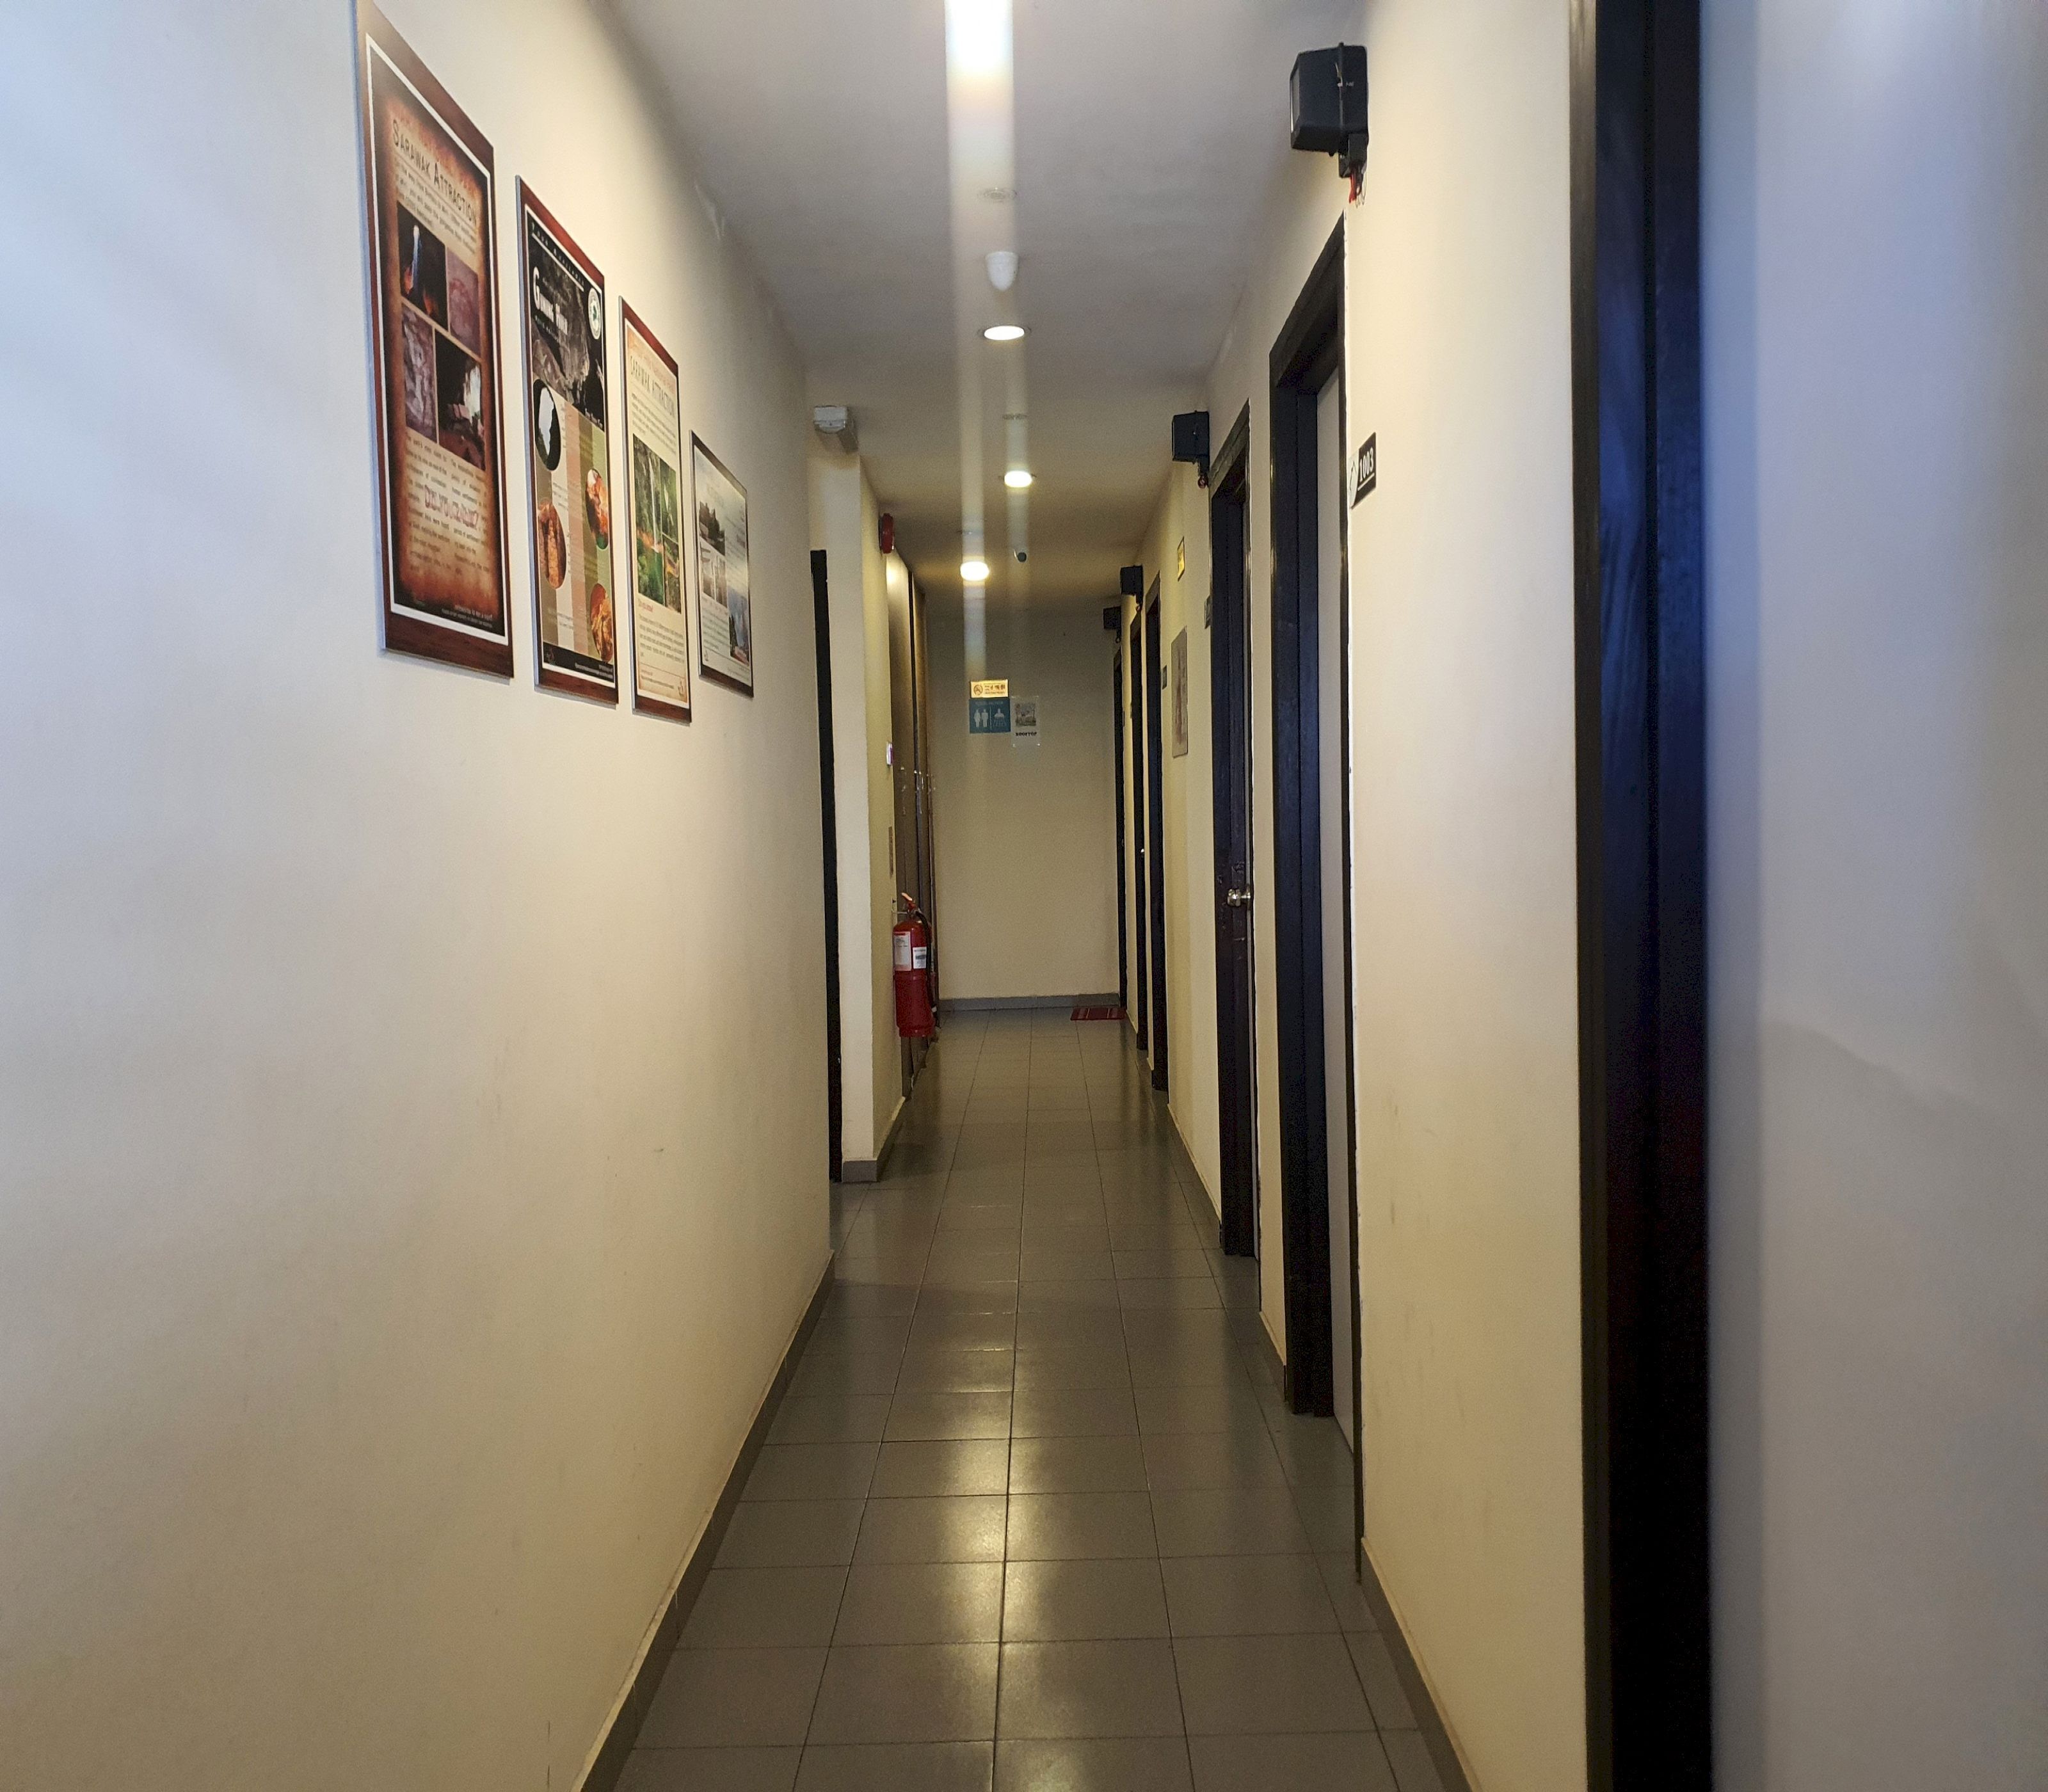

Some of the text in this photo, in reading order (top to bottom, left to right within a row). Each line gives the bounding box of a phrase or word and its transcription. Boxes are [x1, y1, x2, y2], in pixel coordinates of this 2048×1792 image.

[392, 119, 431, 178] SARAWAK
[434, 162, 477, 225] ATTRACTION
[1359, 447, 1374, 483] 1003
